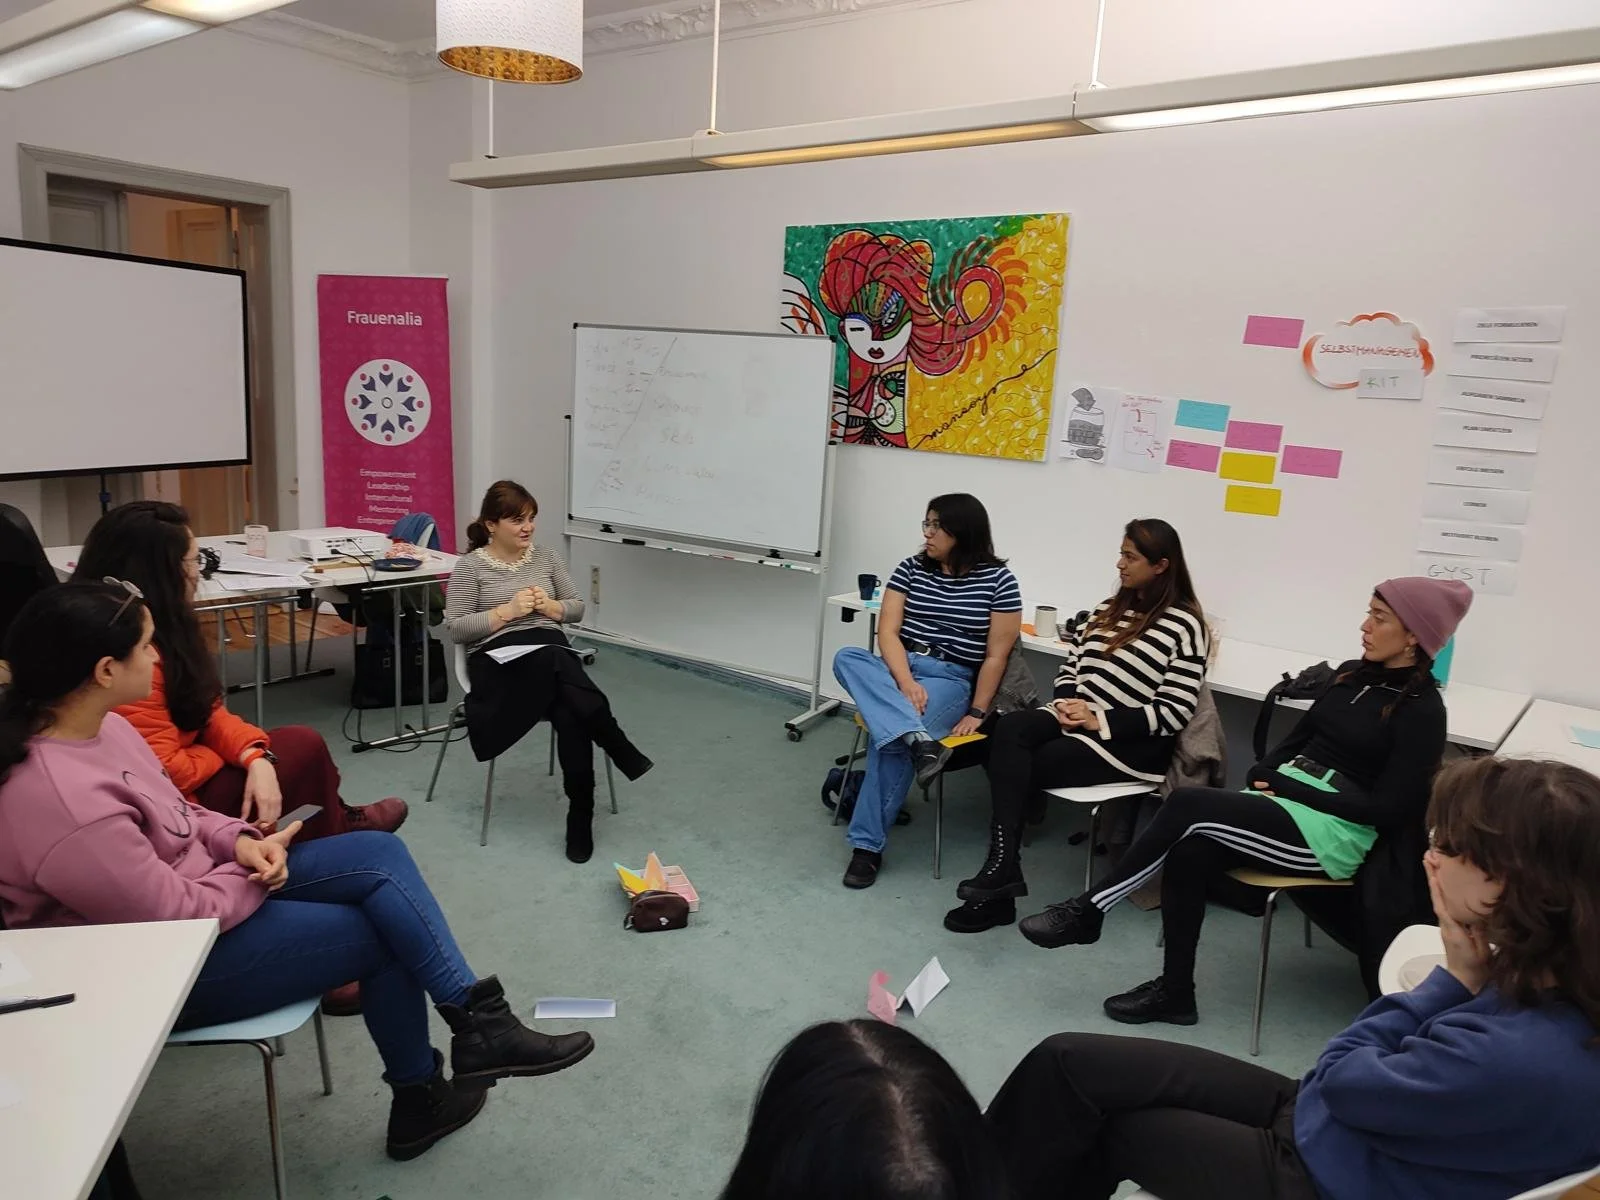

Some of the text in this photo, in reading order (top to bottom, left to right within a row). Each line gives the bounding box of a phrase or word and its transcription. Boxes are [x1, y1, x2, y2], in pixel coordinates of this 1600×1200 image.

[347, 310, 423, 326] Frauenalia
[1366, 375, 1401, 389] KIT
[360, 468, 417, 479] Empowerment
[366, 481, 410, 492] Leadership
[364, 493, 413, 503] Intercultural
[368, 504, 410, 516] Mentoring
[1427, 564, 1493, 586] GYST
